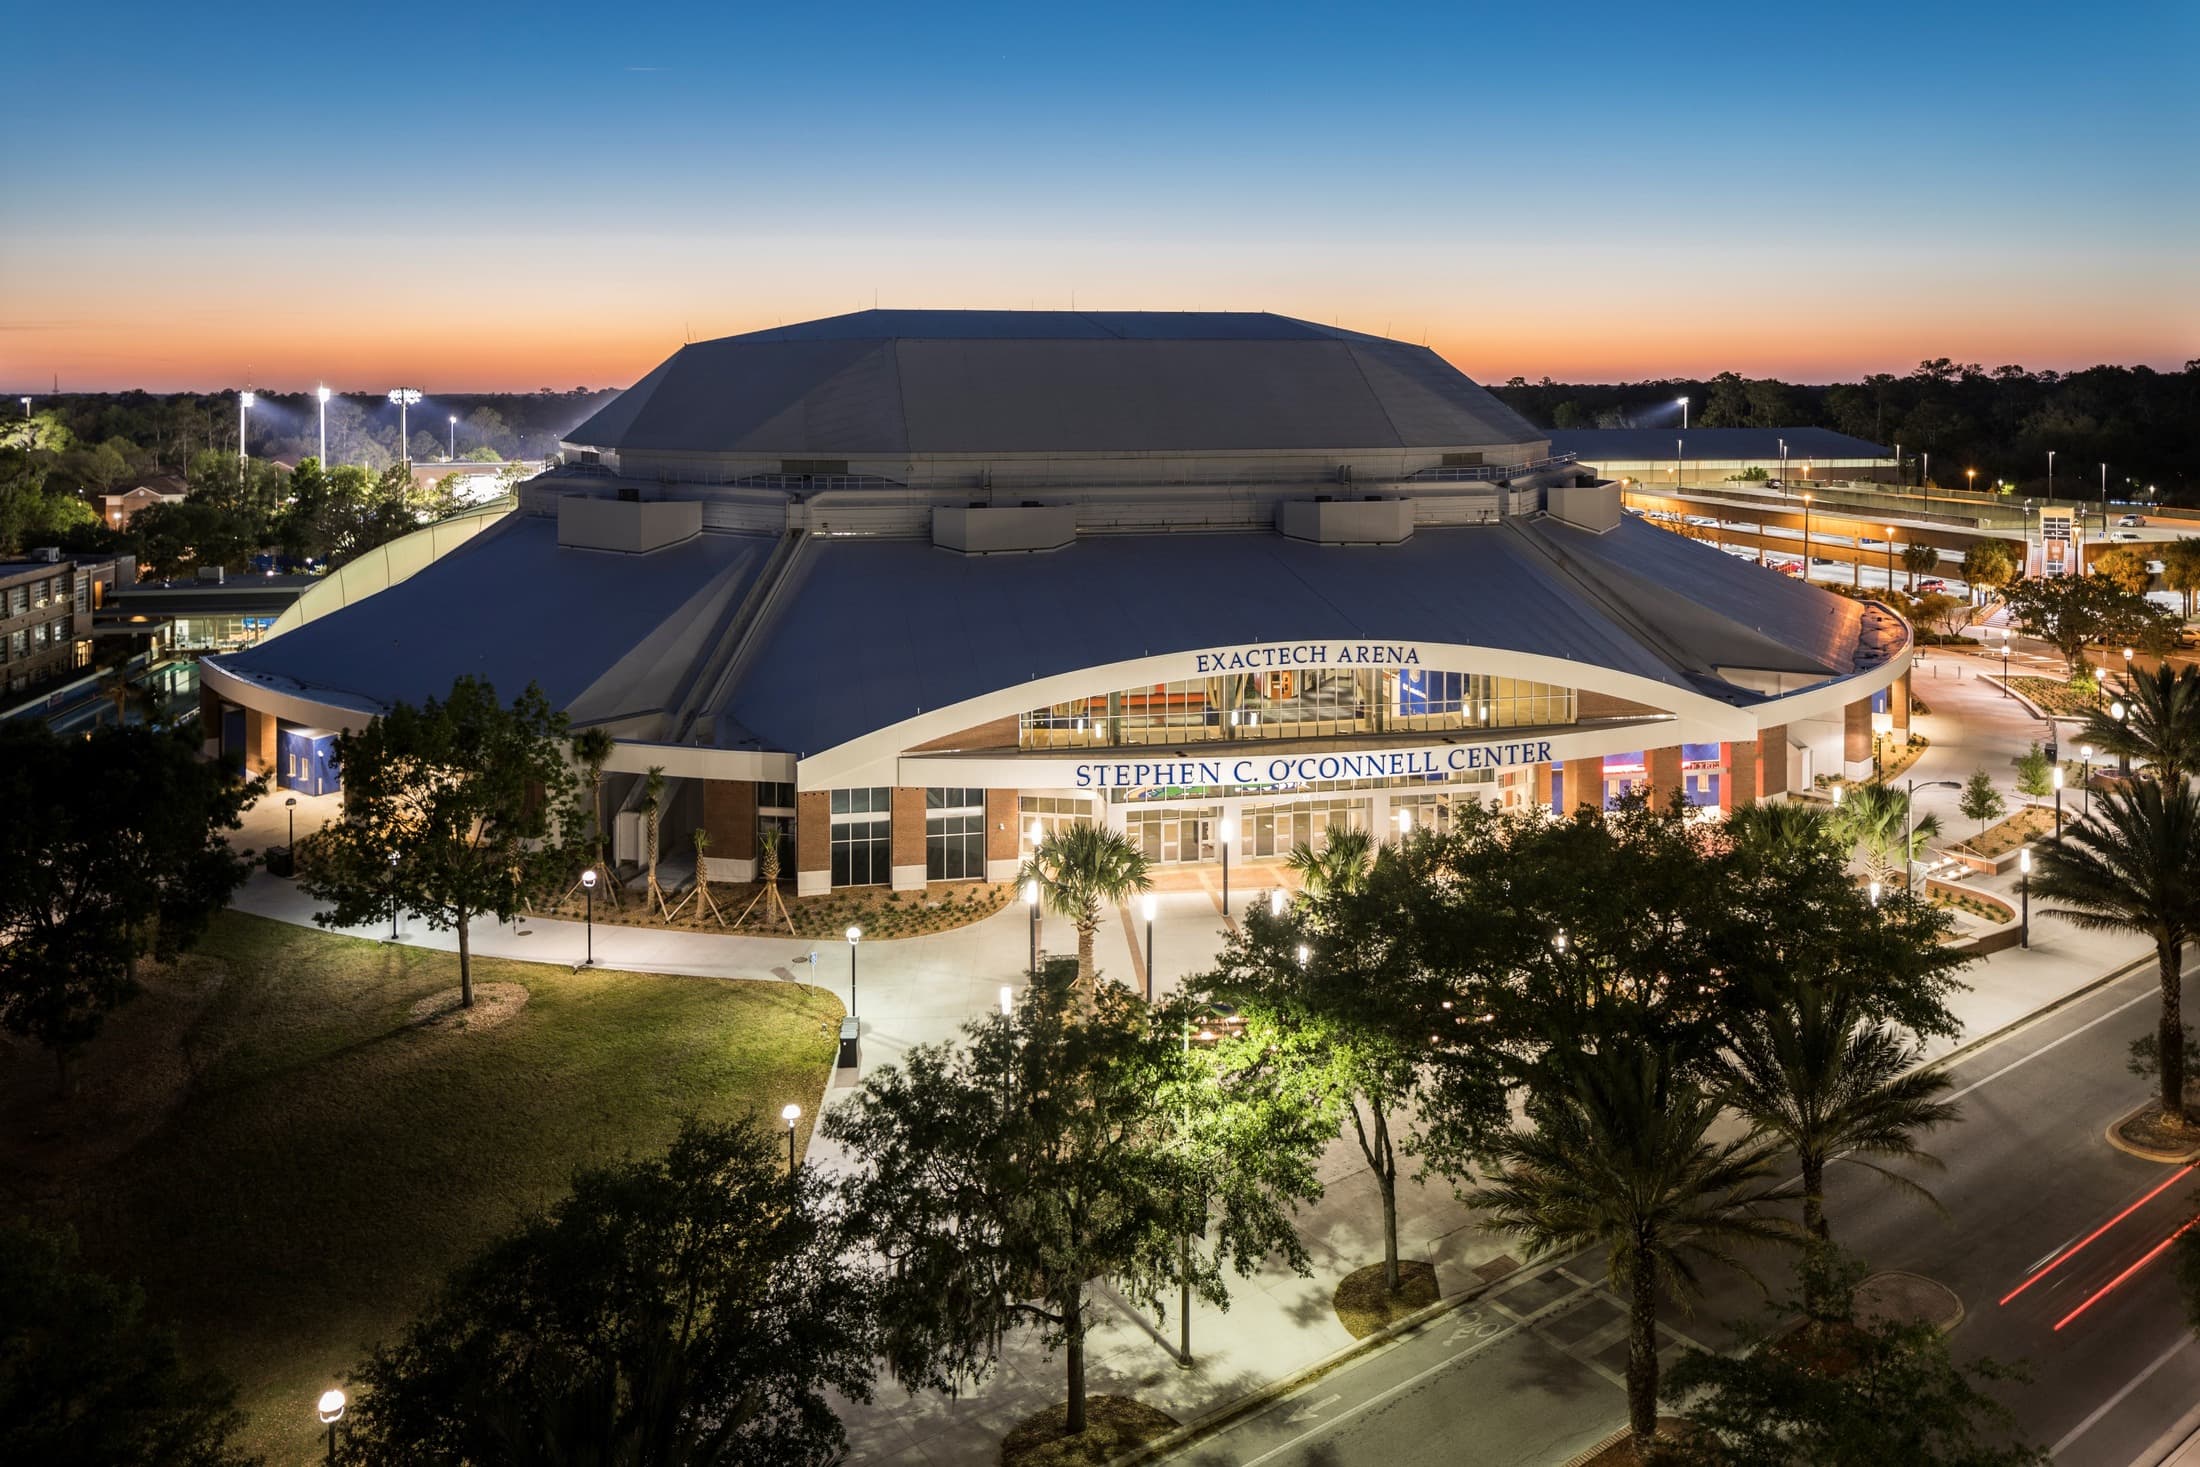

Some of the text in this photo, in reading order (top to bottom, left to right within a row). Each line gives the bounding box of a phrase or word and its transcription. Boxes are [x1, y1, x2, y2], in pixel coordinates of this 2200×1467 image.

[1197, 645, 1420, 673] EXACTECH ARENA
[1076, 763, 1220, 788] STEPHEN
[1233, 761, 1258, 783] C.
[1267, 751, 1439, 782] O'CONNELL
[1448, 741, 1552, 770] CENTER
